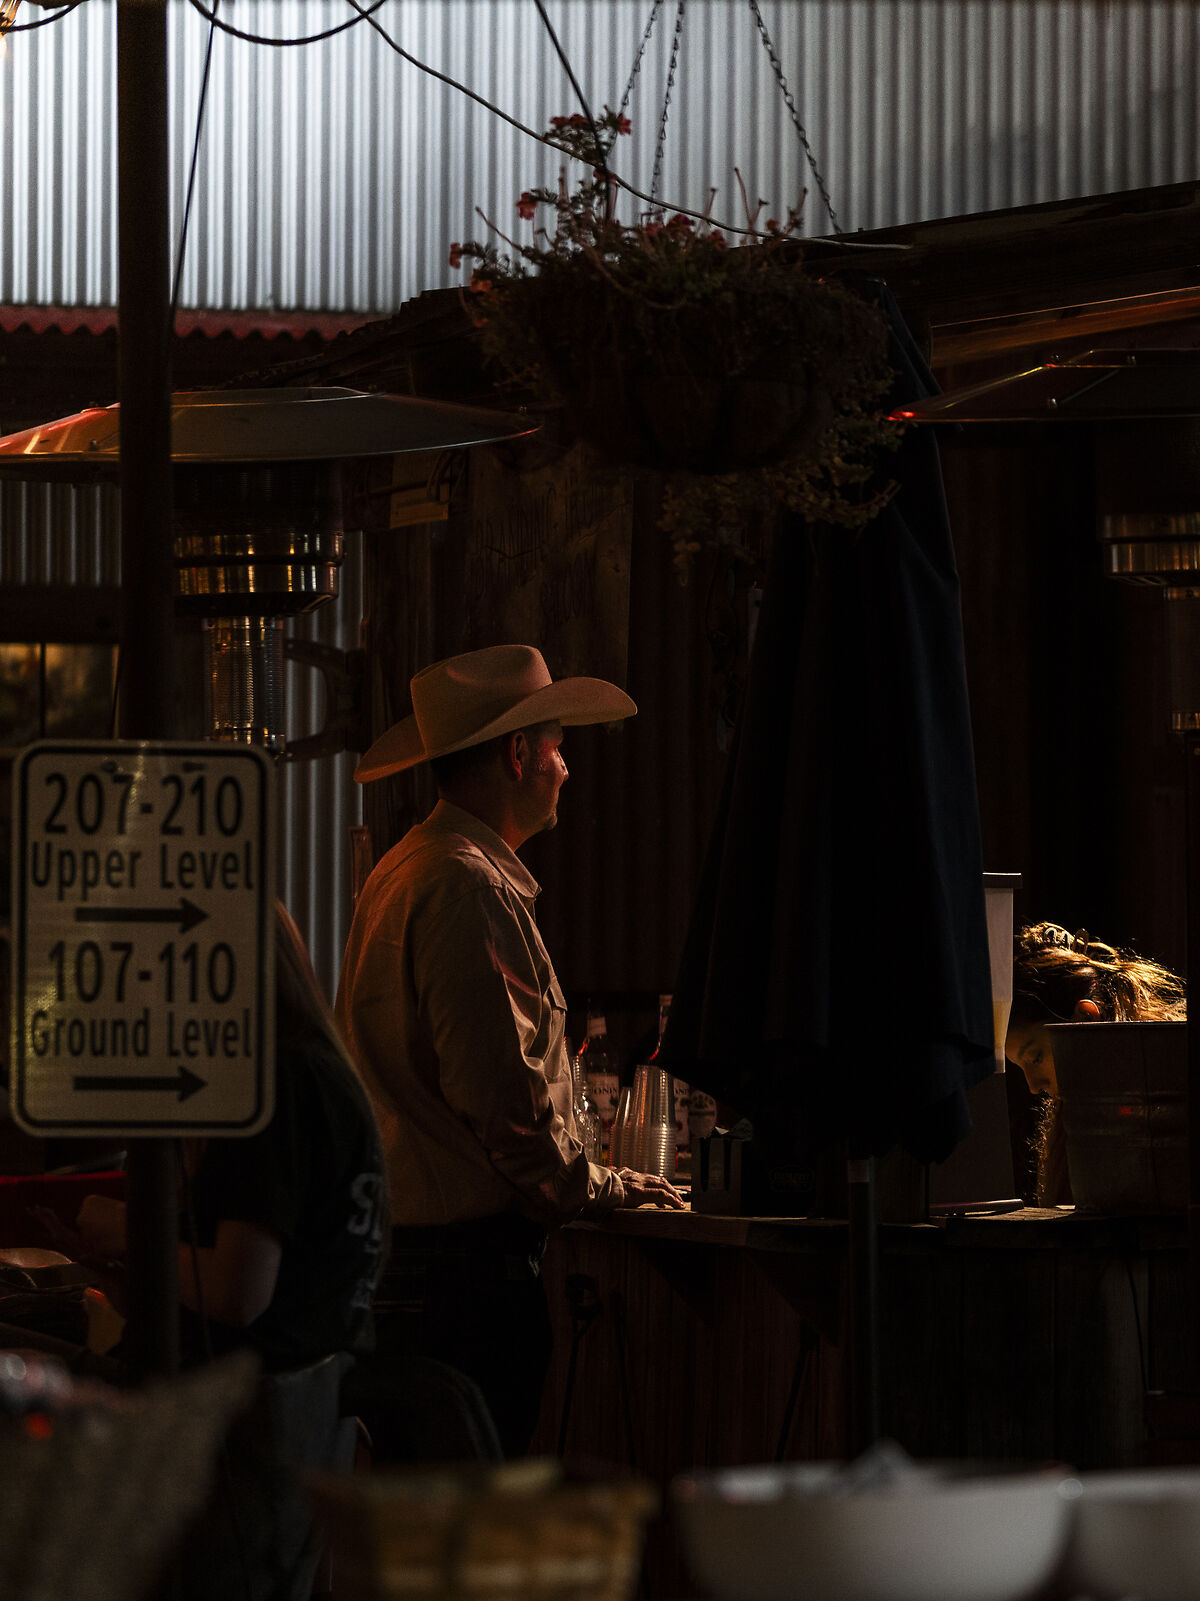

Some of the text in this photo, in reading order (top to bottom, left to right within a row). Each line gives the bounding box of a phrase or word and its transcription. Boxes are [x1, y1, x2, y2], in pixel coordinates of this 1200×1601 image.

[45, 773, 243, 836] 207-210
[31, 841, 254, 900] Upper Level
[49, 942, 235, 1003] 107-110
[31, 1009, 252, 1058] Ground Level
